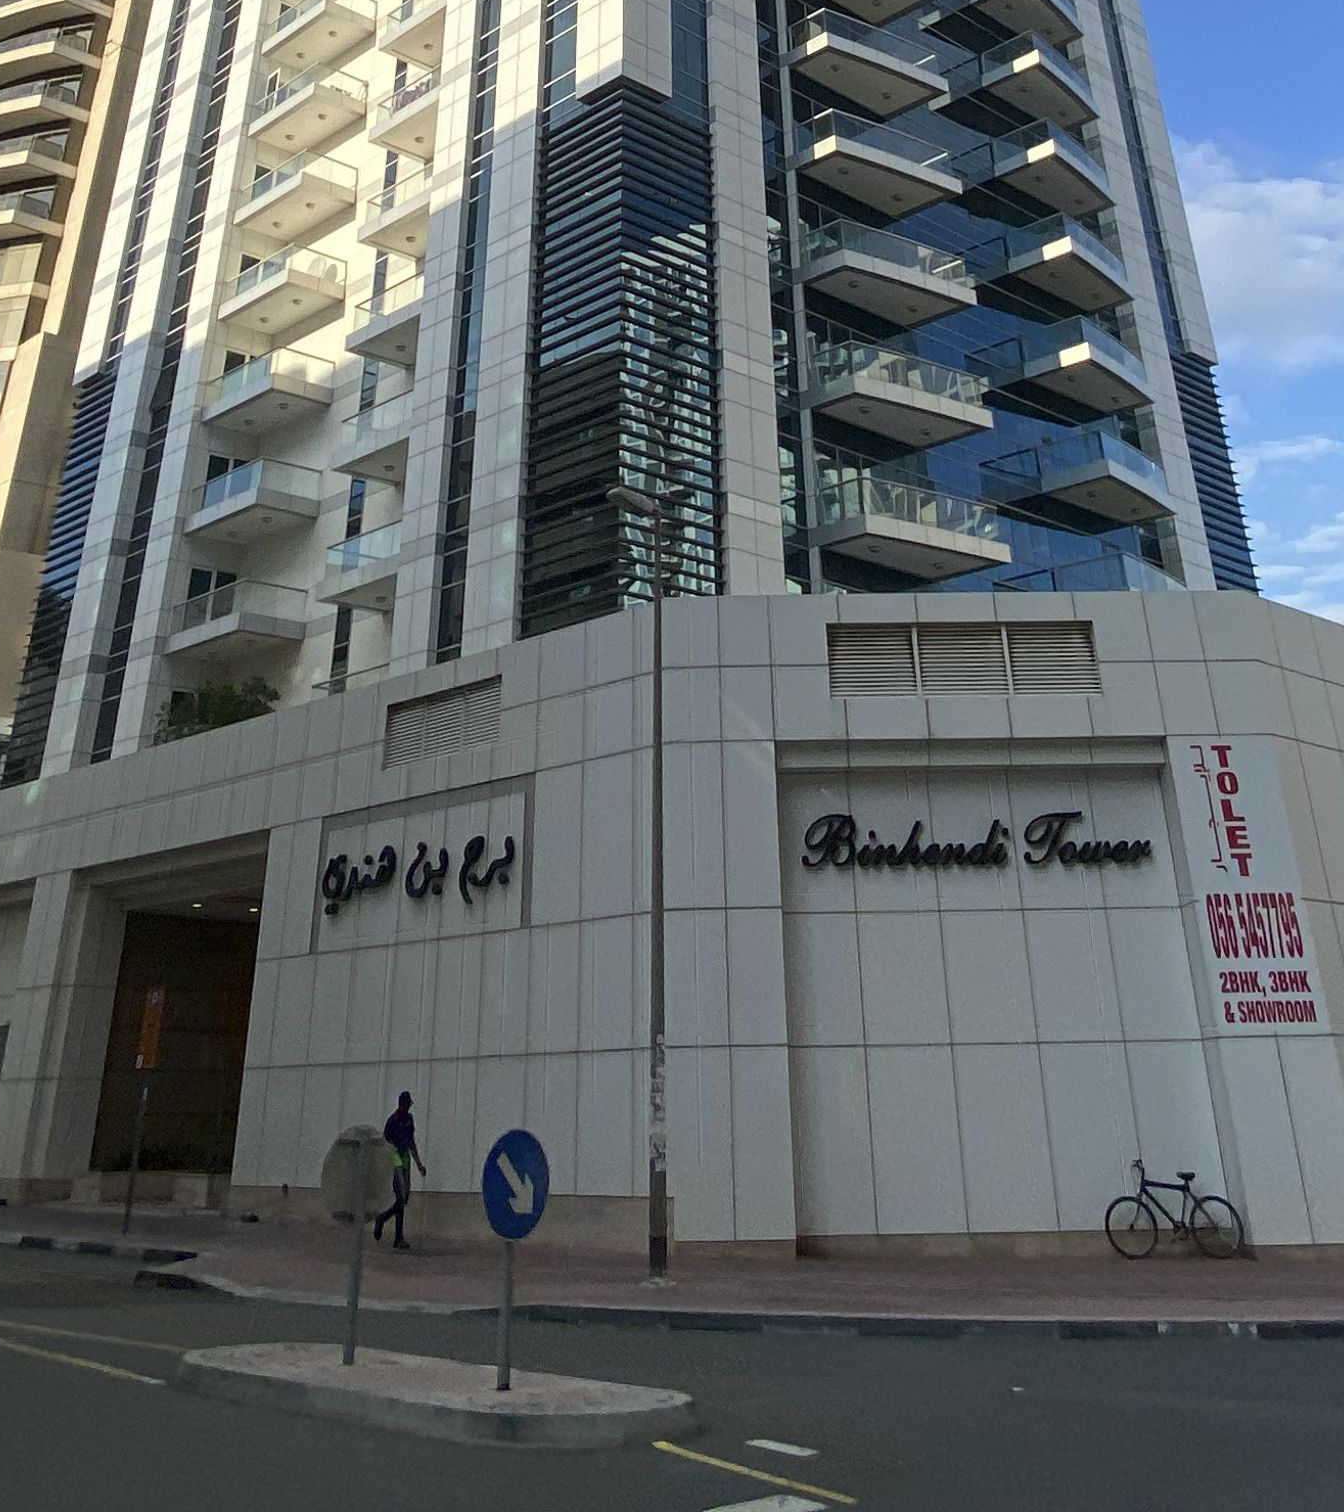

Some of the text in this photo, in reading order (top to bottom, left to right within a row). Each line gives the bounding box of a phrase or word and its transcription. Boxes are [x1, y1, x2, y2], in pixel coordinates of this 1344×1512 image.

[802, 810, 1152, 868] Binhendi Tower
[322, 836, 515, 916] برج بن هندي
[1206, 892, 1304, 959] 056 5457795
[1219, 970, 1312, 998] 2BHK, 3BHK
[1223, 999, 1317, 1024] & SHOWROOM
